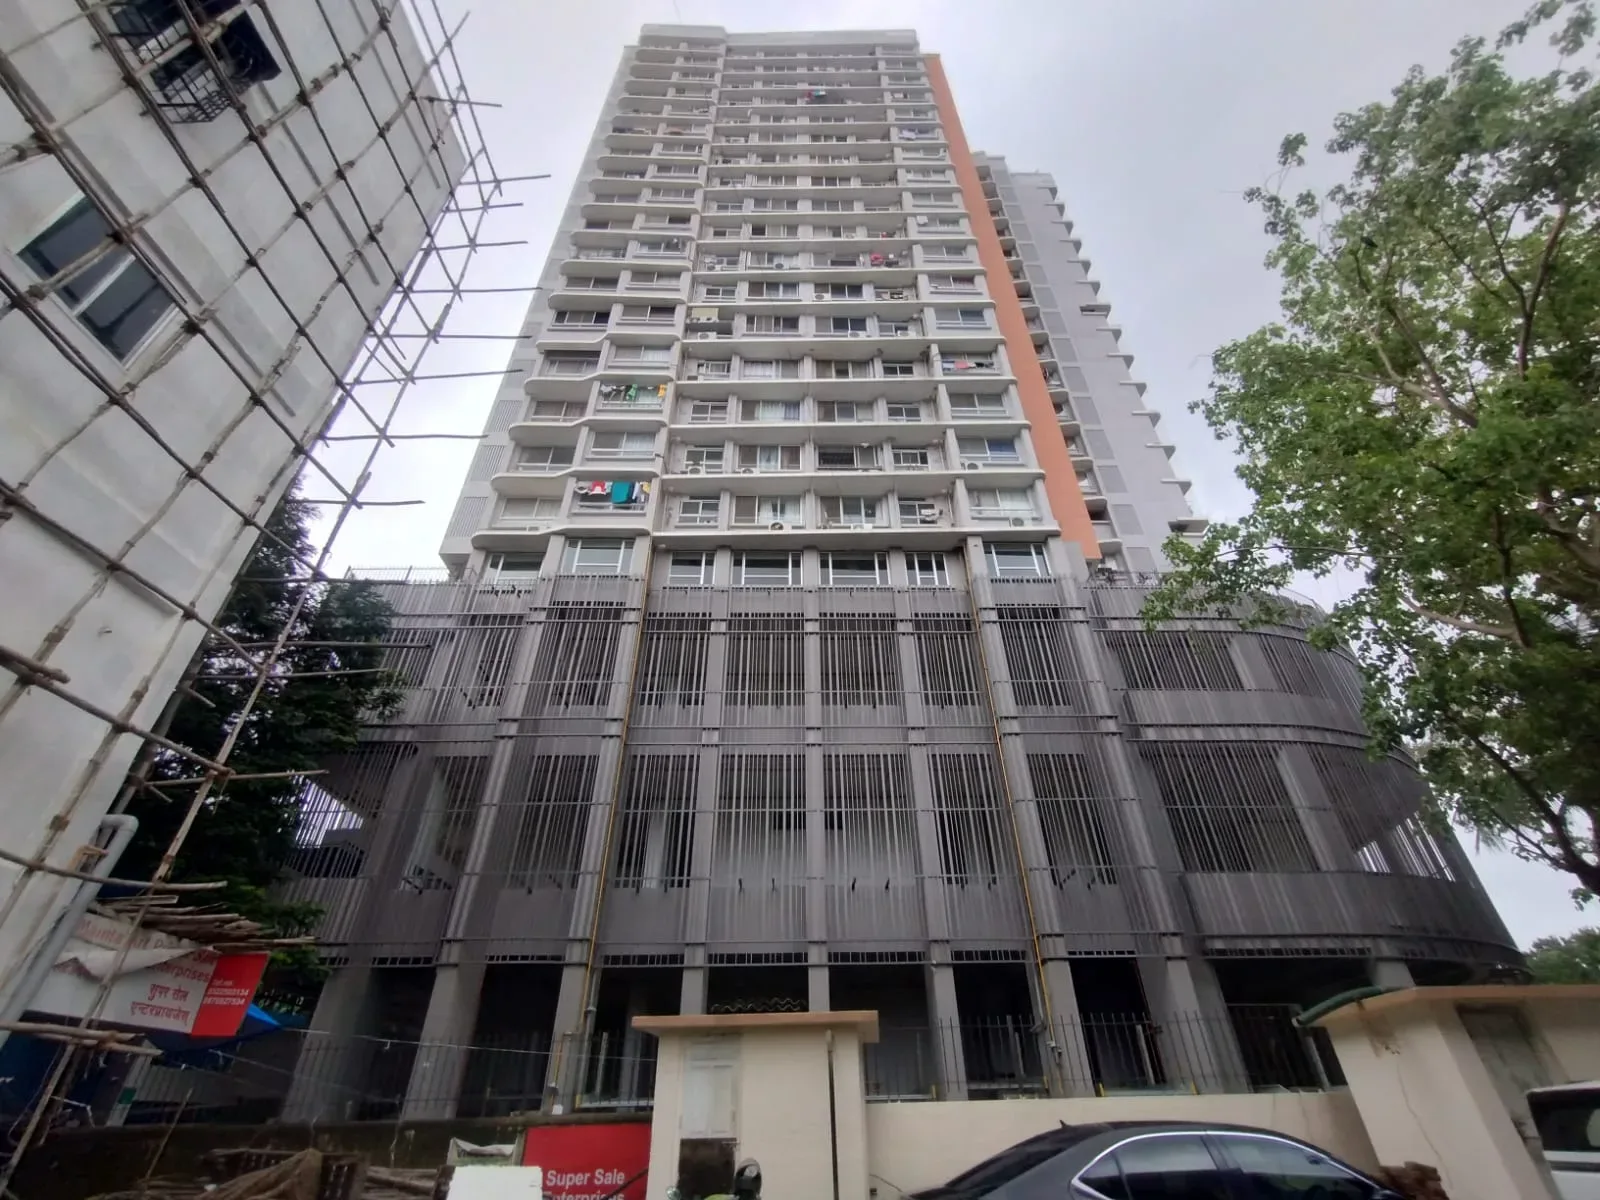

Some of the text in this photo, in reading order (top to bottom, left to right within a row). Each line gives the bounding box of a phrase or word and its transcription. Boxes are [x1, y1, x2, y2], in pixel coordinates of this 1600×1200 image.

[546, 1168, 625, 1190] Super Sale
[543, 1190, 625, 1200] nterpris
